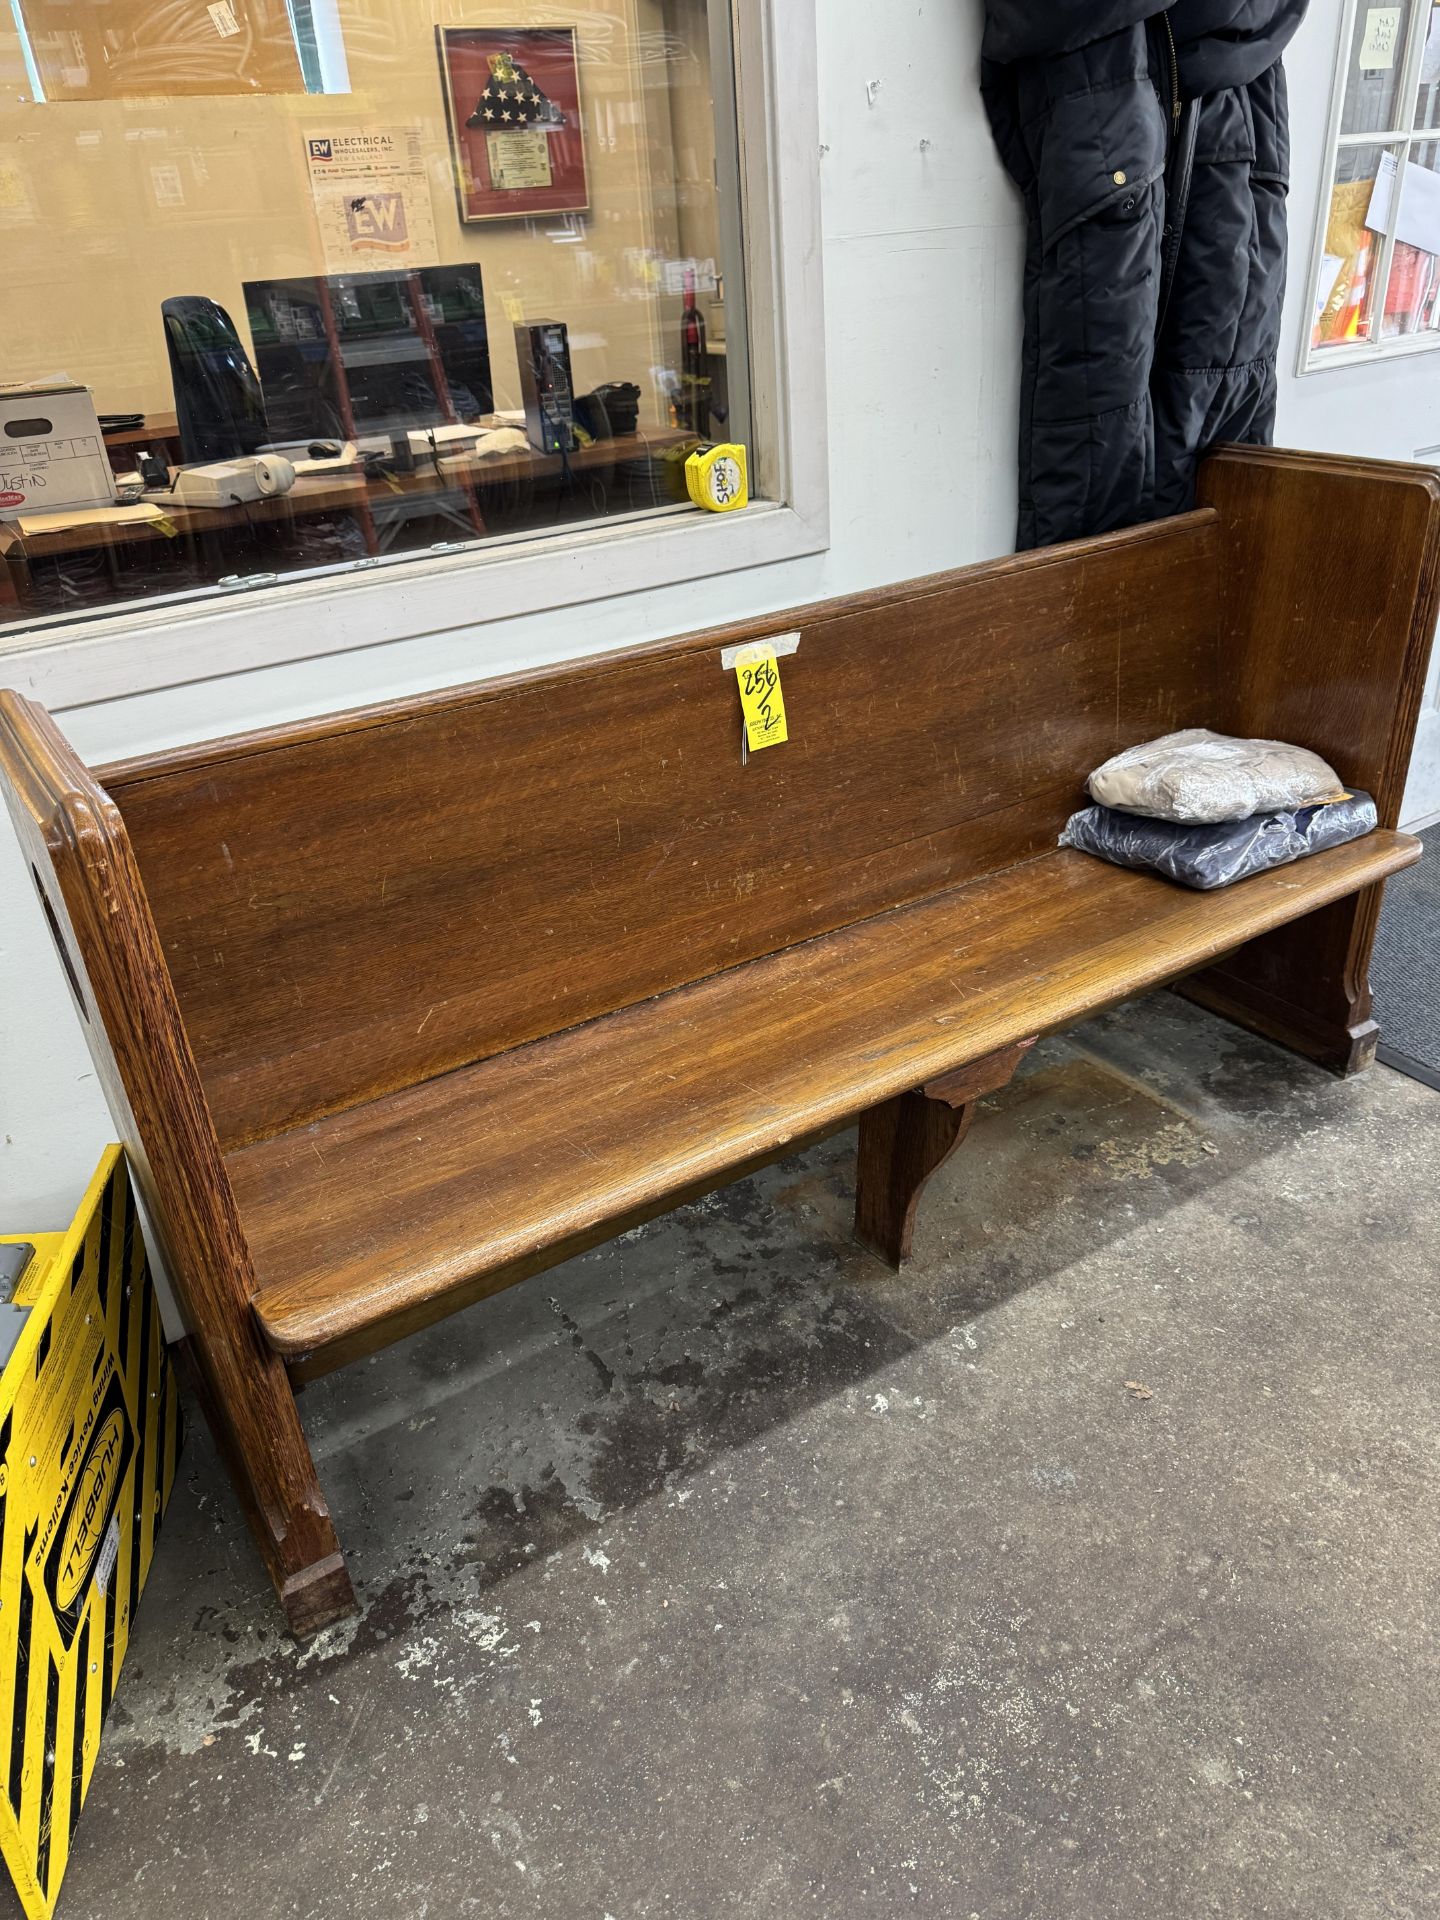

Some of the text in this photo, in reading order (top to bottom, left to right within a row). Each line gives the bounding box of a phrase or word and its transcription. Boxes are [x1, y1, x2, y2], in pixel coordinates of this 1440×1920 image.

[333, 136, 394, 147] ELECTRICAL
[353, 198, 398, 235] EW
[742, 660, 777, 695] 256
[761, 704, 781, 731] 2
[93, 1352, 114, 1408] Wiring
[36, 1408, 93, 1567] Device-Kellems
[62, 1424, 119, 1583] HUBBELL
